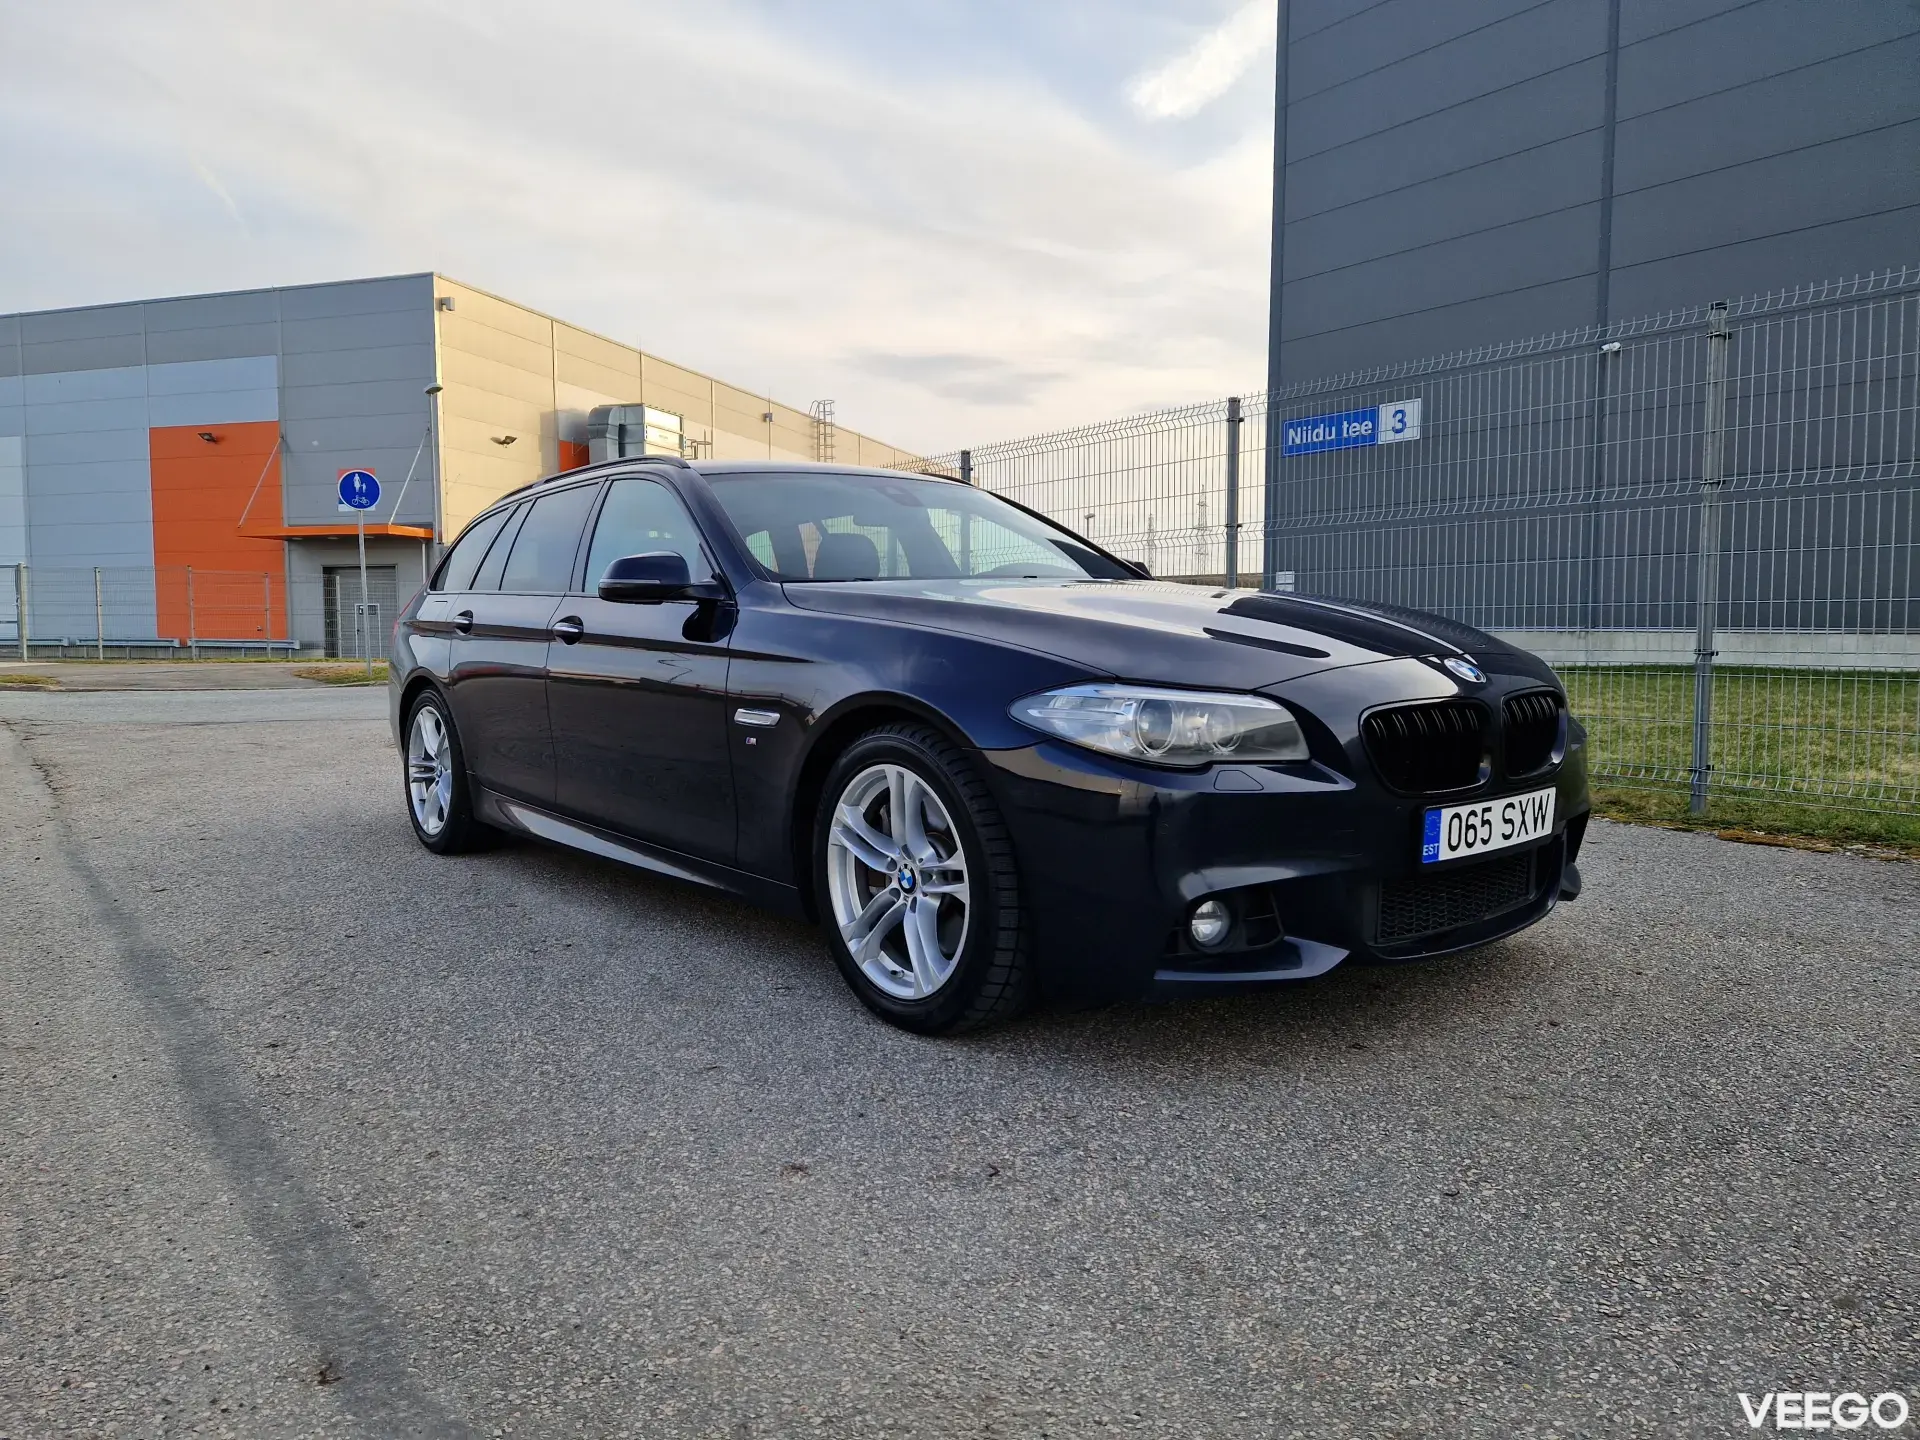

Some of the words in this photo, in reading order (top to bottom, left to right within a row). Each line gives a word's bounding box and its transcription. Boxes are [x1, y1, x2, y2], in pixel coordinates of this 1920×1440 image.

[1288, 423, 1335, 445] Niidu
[1342, 420, 1372, 438] tee
[1391, 409, 1407, 434] 3
[1447, 806, 1492, 852] 065
[1501, 793, 1550, 840] SXW
[1422, 843, 1440, 856] EST
